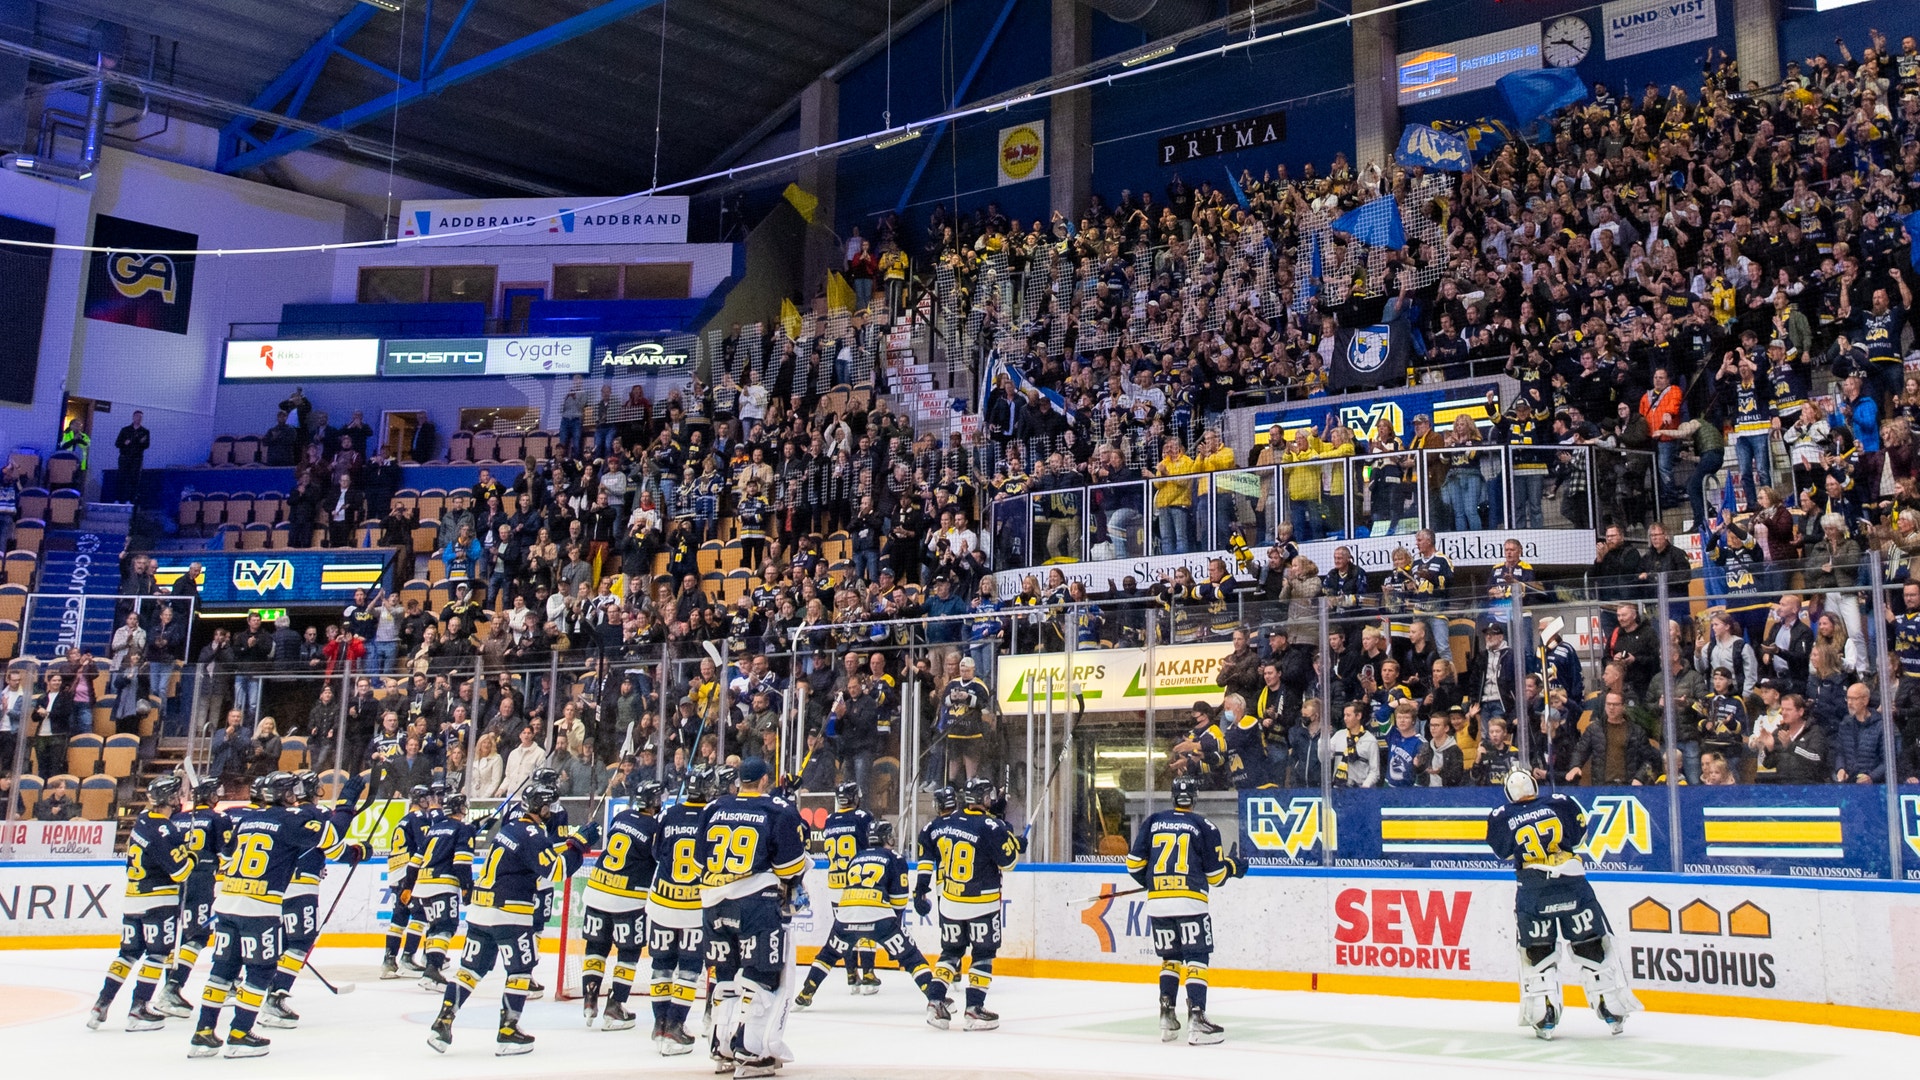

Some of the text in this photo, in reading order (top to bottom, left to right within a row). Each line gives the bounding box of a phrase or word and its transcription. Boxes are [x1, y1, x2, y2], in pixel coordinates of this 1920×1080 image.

[1612, 1, 1704, 29] LUNDQVIST
[1460, 47, 1524, 71] FASTIGHETER
[1164, 124, 1277, 163] PRIMA
[440, 215, 537, 228] ADDBRAND
[584, 213, 681, 226] ADDBRAND
[389, 351, 484, 364] TOSITO
[505, 341, 572, 361] Cygate
[232, 559, 295, 595] HV71
[1160, 677, 1209, 686] EQUIPMENT
[717, 810, 766, 824] Husqvarna
[1159, 821, 1200, 837] Husqvarna
[1247, 797, 1338, 860] HV71
[706, 825, 759, 874] 39
[1515, 815, 1562, 866] 37
[602, 832, 632, 872] 9
[1152, 832, 1191, 875] 71
[1246, 857, 1304, 866] ONRADSSONS
[1335, 858, 1399, 868] KONRADSSONS
[1430, 859, 1498, 869] KONRADSSONS
[1583, 861, 1627, 871] ADSSONS
[1684, 863, 1756, 875] KONRADSSONS
[1790, 866, 1862, 878] KONRADSSONS
[1153, 875, 1189, 890] VESEL
[0, 883, 112, 920] NRIX
[583, 915, 602, 936] JP
[1334, 888, 1472, 946] SEW
[1571, 908, 1594, 935] JP
[651, 930, 674, 951] JP
[679, 928, 703, 951] JP
[942, 924, 961, 943] JP
[969, 922, 988, 943] JP
[1155, 929, 1176, 950] JP
[1179, 921, 1200, 945] JP
[706, 941, 731, 962] JP
[829, 935, 849, 953] JP
[884, 933, 905, 955] JP
[1335, 945, 1471, 971] EURODRIVE
[1631, 943, 1776, 988] EKSJÖHUS
